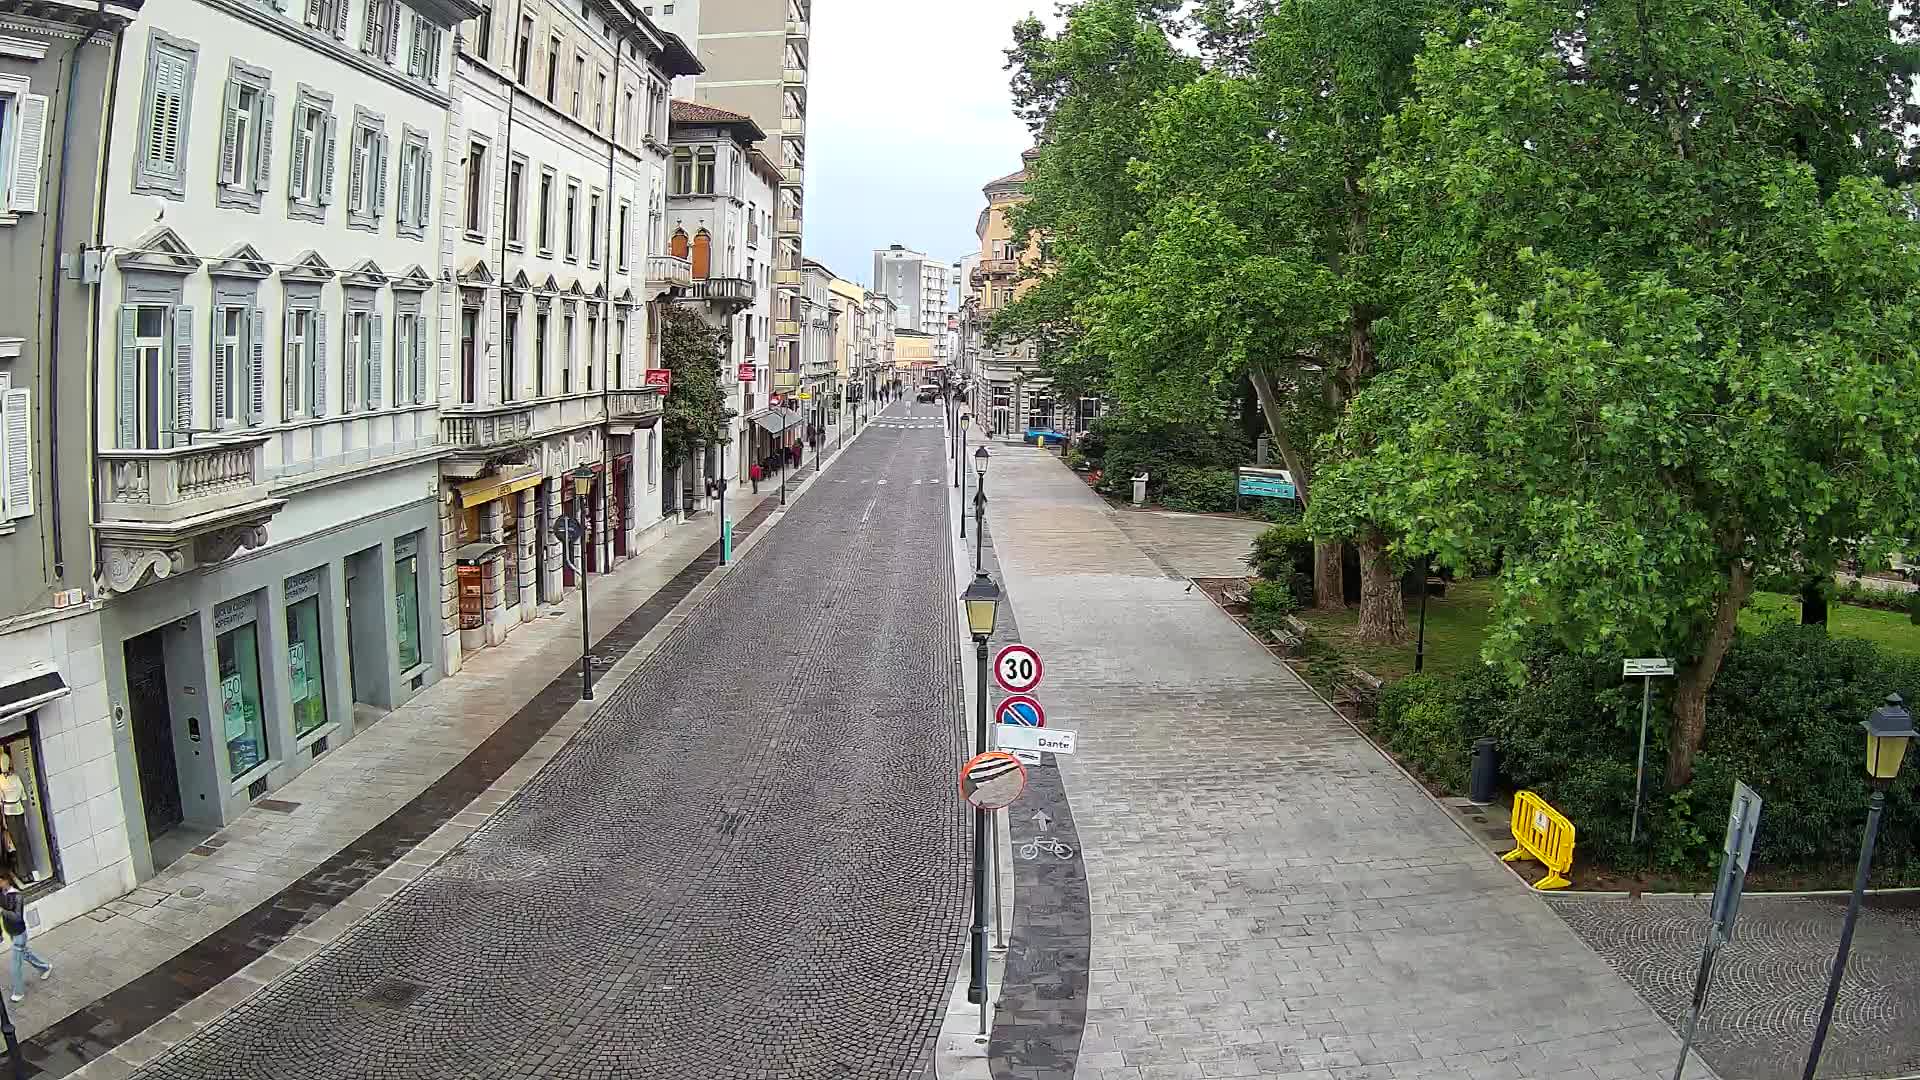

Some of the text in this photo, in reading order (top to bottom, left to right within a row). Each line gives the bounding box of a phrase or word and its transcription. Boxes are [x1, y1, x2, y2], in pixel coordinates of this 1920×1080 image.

[1005, 658, 1033, 680] 30
[222, 677, 241, 700] 130
[1038, 738, 1070, 750] Dante
